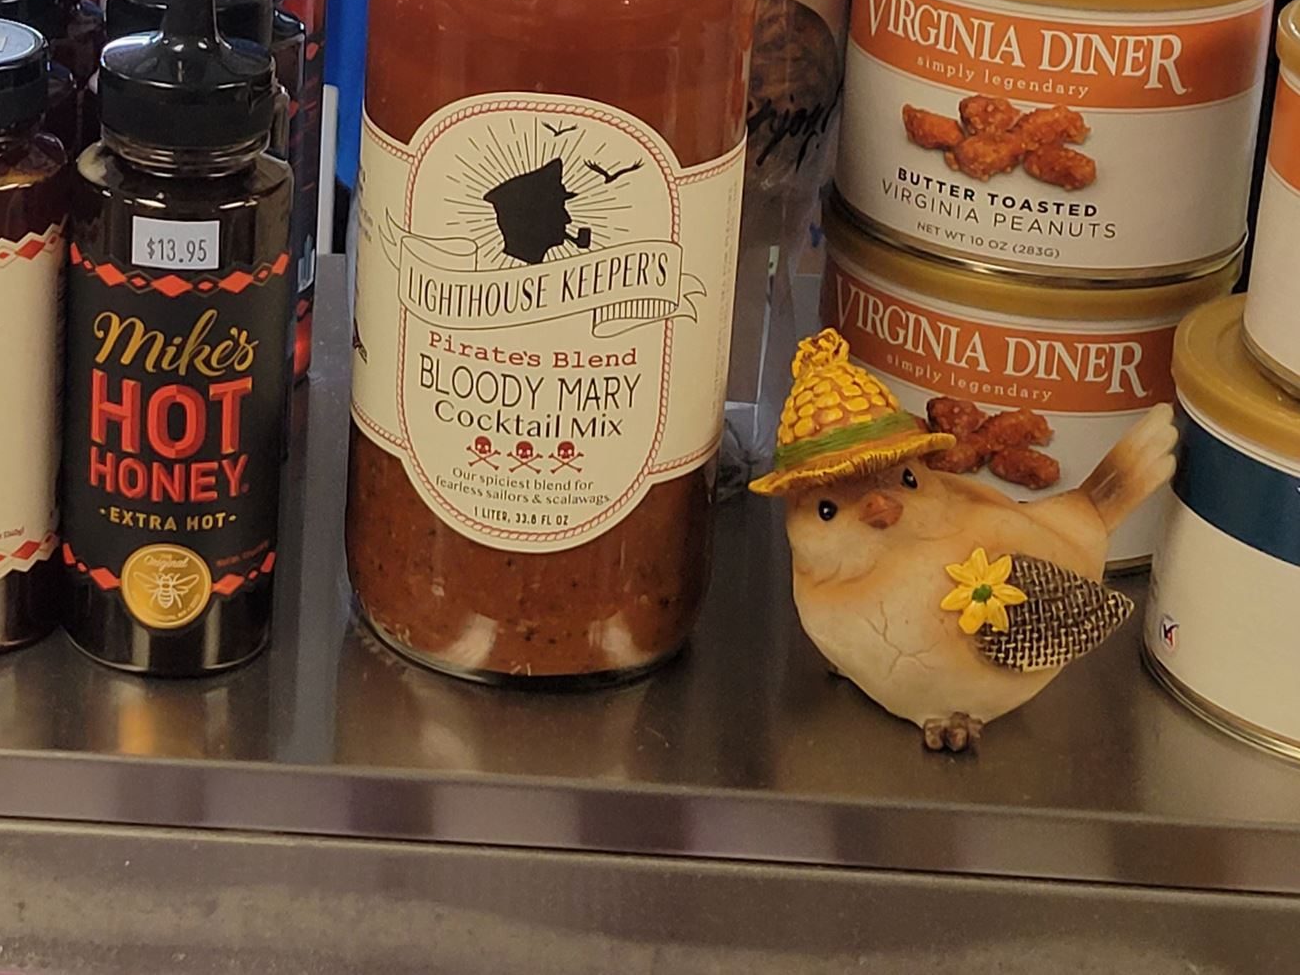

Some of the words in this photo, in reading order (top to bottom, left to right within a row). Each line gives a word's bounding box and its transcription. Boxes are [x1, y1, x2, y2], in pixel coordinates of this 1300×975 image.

[917, 55, 975, 83] simply
[984, 65, 1090, 99] legendary
[1039, 28, 1186, 95] DINER
[881, 180, 980, 225] VIRGINIA
[994, 212, 1117, 240] PEANUTS
[897, 167, 975, 202] BUTTER
[987, 193, 1098, 218] TOASTED
[146, 237, 208, 264] $13.95
[917, 221, 940, 239] NET
[944, 229, 966, 244] WT
[970, 234, 984, 248] 10
[988, 239, 1008, 252] OZ
[1012, 241, 1061, 260] (283G)
[407, 266, 551, 319] LIGHTHOUSE
[561, 252, 669, 304] KEEPER'S
[93, 308, 259, 377] Mike's
[429, 331, 541, 368] Pirate's
[552, 348, 638, 369] Blend
[836, 274, 990, 373] VIRGINIA
[1004, 335, 1148, 399] DINER
[419, 353, 545, 410] BLOODY
[559, 373, 642, 411] MARY
[886, 355, 942, 383] simply
[950, 371, 1053, 403] legendary
[90, 367, 253, 459] HOT
[435, 401, 561, 438] Cocktail
[571, 415, 623, 438] Mix
[89, 446, 249, 502] HONEY
[435, 475, 483, 497] fearless
[486, 489, 529, 504] sailors
[531, 494, 543, 504] &
[452, 467, 477, 481] Our
[479, 474, 530, 490] spiciest
[534, 479, 571, 491] blend
[574, 479, 594, 491] for
[482, 508, 511, 523] LITER,
[541, 514, 552, 526] FL
[556, 515, 569, 526] OZ
